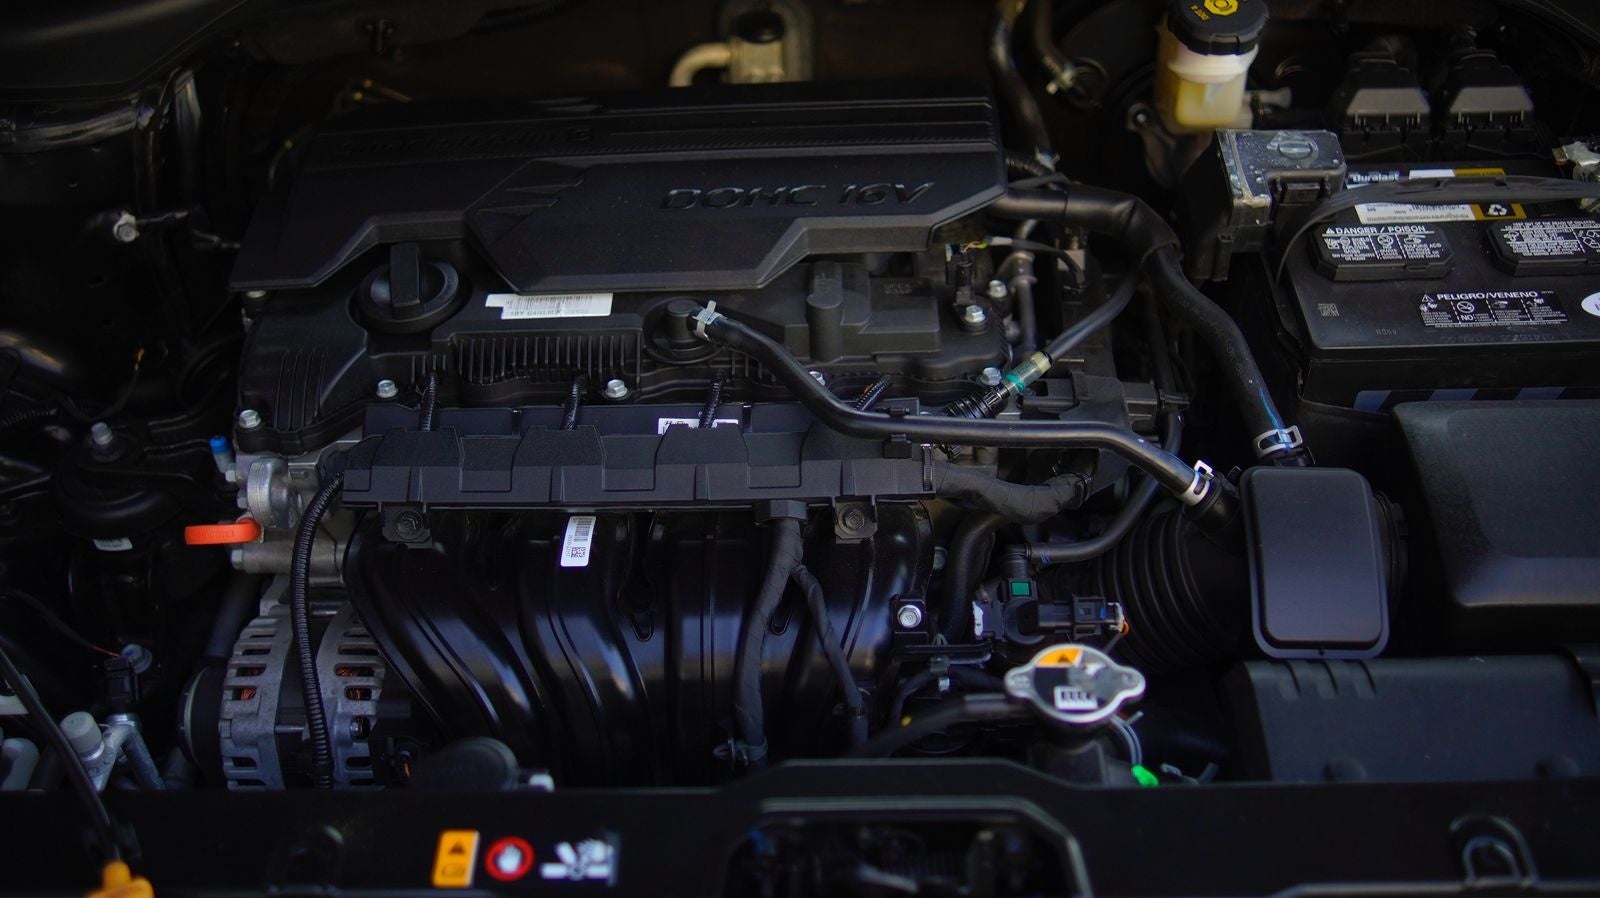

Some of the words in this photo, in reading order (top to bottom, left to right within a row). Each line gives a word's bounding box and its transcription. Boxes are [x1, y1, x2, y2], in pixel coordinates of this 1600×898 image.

[1352, 171, 1399, 183] Duralast
[661, 184, 828, 209] DOHC
[838, 181, 936, 206] 16V
[1335, 226, 1377, 235] DANGER
[1387, 224, 1427, 234] POISON
[1437, 290, 1538, 301] PELIGRO/VENENO
